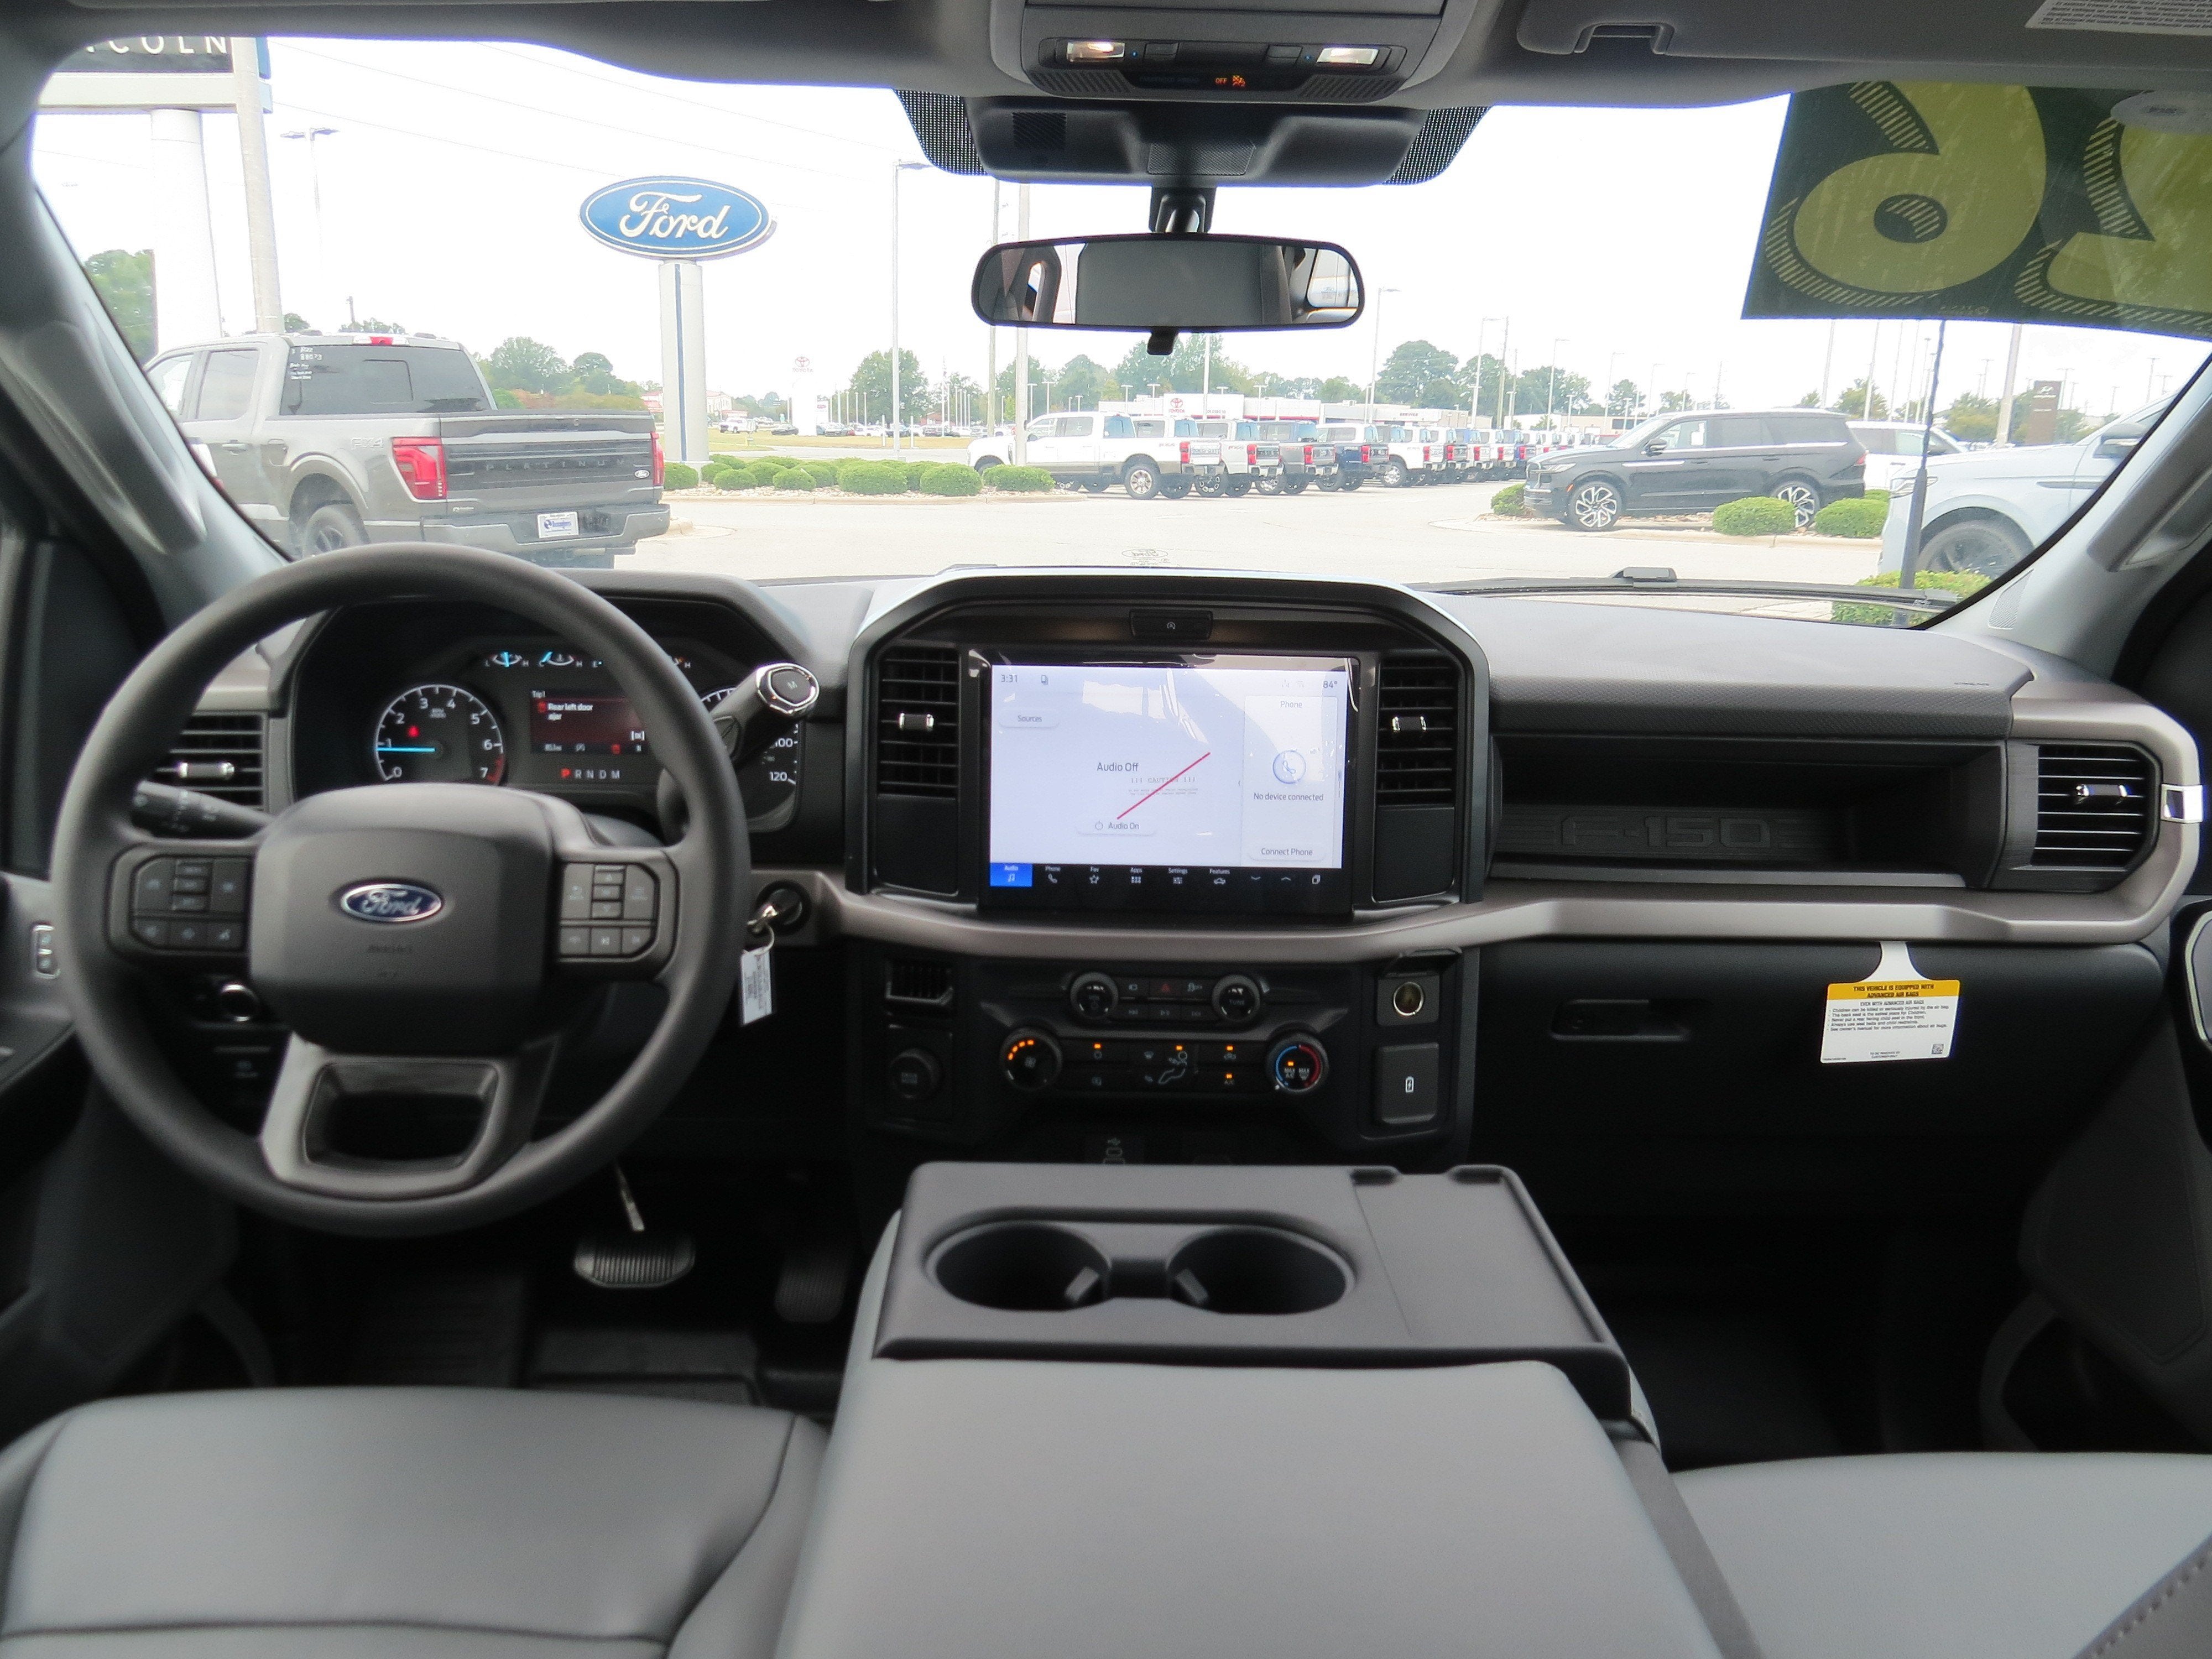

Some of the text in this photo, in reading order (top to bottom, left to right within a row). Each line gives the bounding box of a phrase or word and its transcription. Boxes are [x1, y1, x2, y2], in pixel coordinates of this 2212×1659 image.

[619, 191, 731, 239] Ford
[351, 437, 383, 451] FX4
[486, 458, 625, 471] PLATINUM
[1000, 675, 1018, 683] 3:31
[787, 681, 797, 690] M
[419, 697, 428, 709] 3
[446, 698, 456, 708] 4
[395, 712, 405, 724] 2
[471, 713, 480, 724] 5
[484, 739, 493, 750] 6
[393, 766, 402, 778] 0
[1097, 762, 1139, 771] Audio Off
[479, 767, 488, 778] 7
[561, 768, 620, 779] P R N D M
[769, 771, 787, 781] 120
[1561, 816, 1770, 848] F-150
[362, 888, 423, 915] Ford
